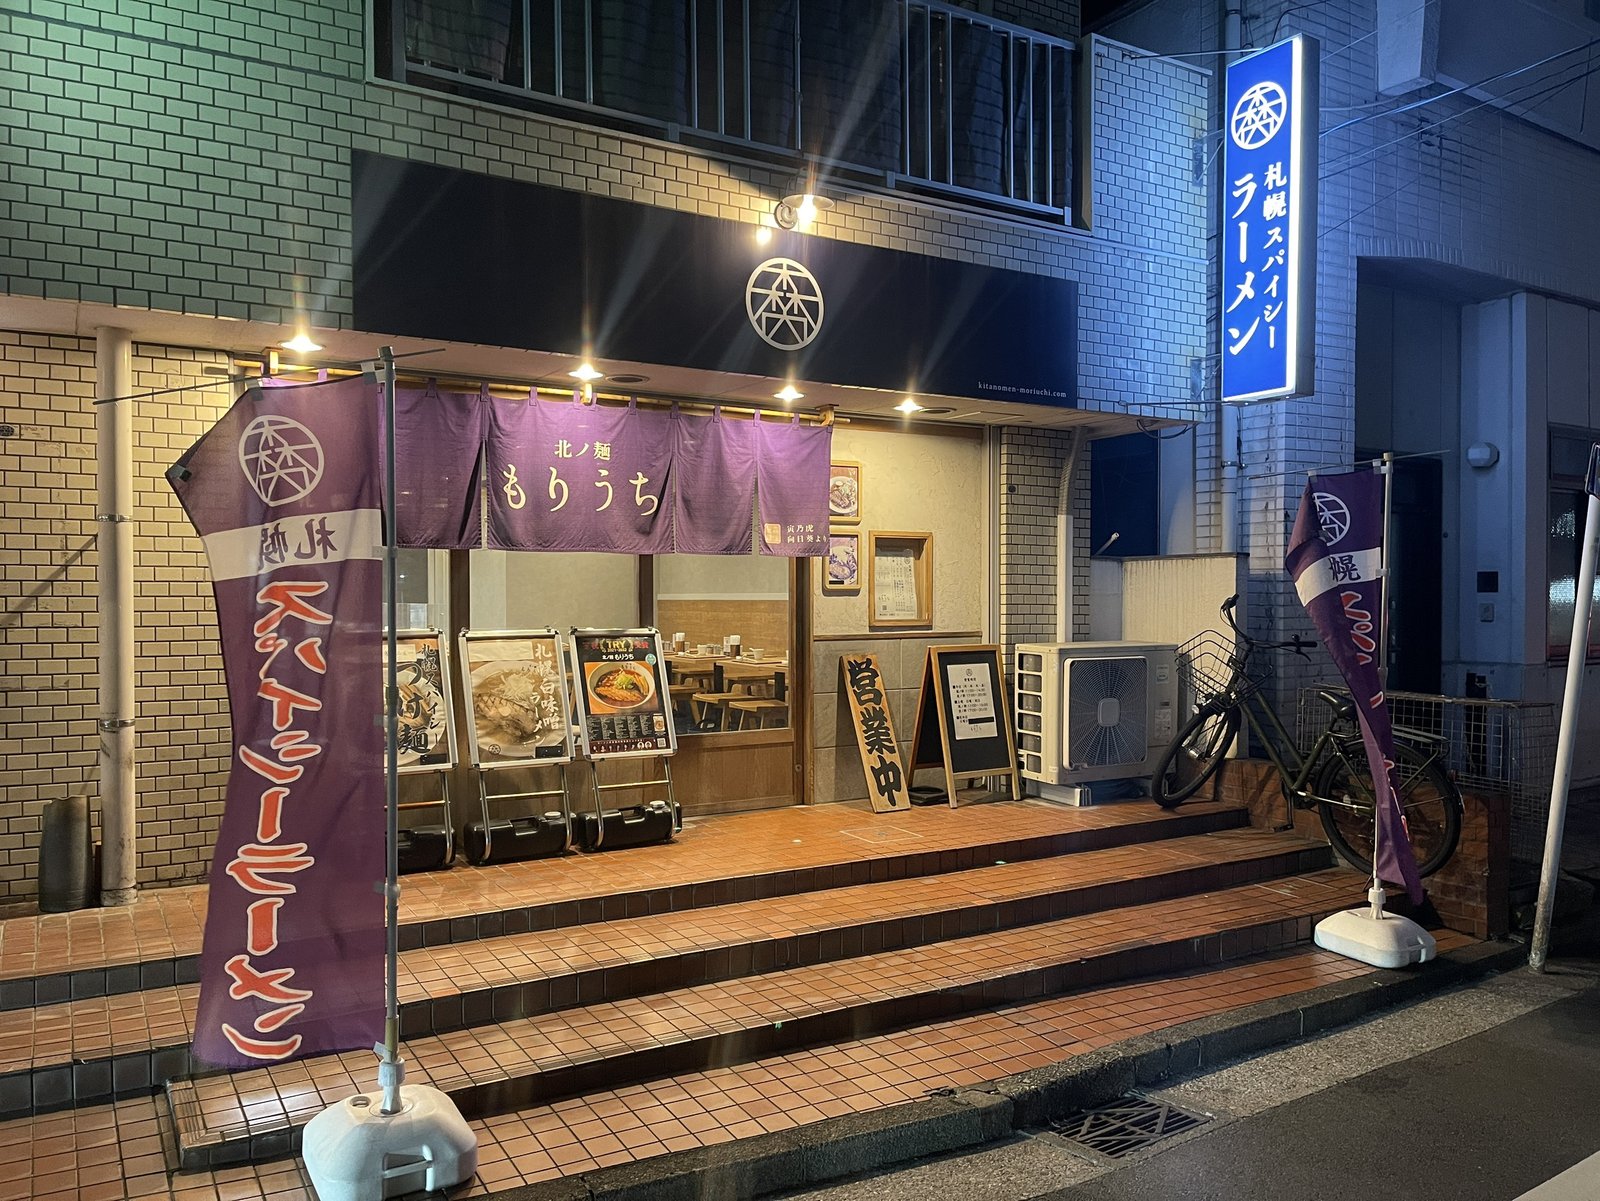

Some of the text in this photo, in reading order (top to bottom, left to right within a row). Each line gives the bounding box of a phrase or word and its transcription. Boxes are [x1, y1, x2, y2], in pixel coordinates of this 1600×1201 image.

[1226, 171, 1260, 356] ラーメン
[1262, 161, 1288, 350] 札幌スパイシー
[978, 381, 1067, 398] kitanomen-moriuchi.com
[554, 439, 611, 461] 北ノ麺
[502, 463, 661, 517] もりうち
[606, 639, 626, 649] TRY
[848, 657, 902, 807] 営業中
